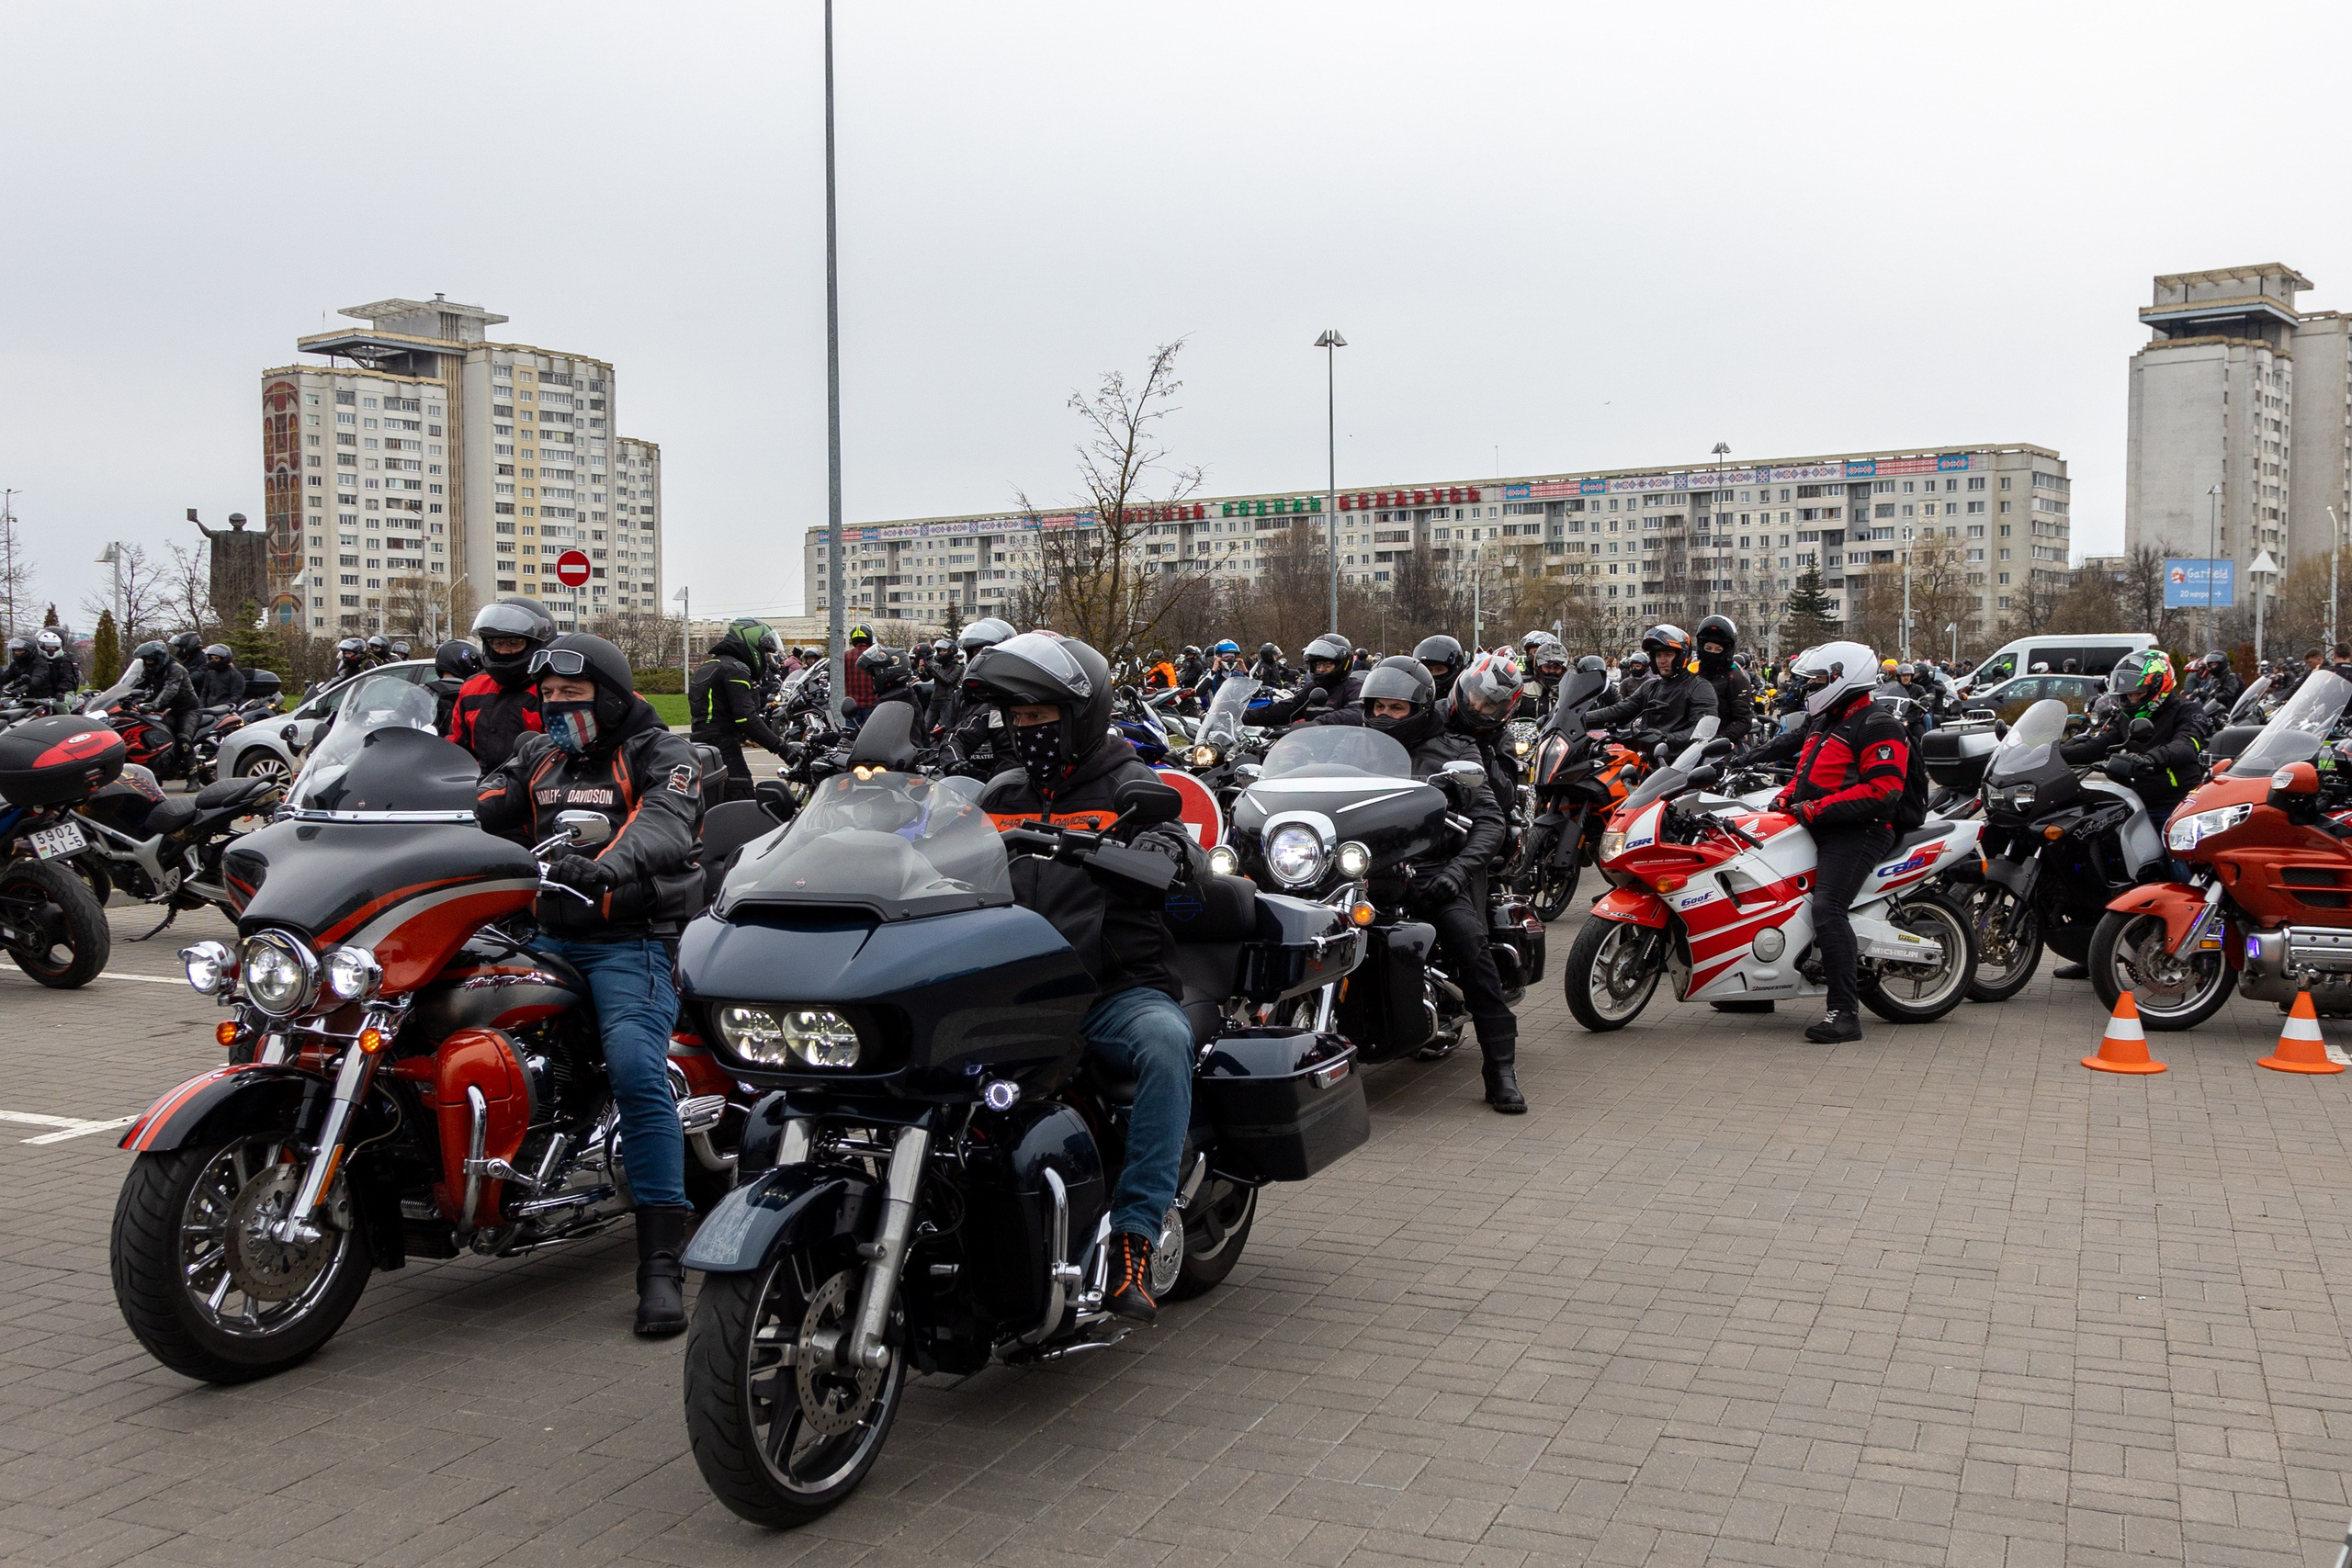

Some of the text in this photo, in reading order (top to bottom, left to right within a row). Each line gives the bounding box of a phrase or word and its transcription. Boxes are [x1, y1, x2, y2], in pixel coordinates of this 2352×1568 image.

[1339, 487, 1480, 510] БЕЛАРУСЬ
[2187, 568, 2229, 580] Garfeld
[2180, 590, 2189, 598] 20
[536, 789, 613, 806] HARLEY- DAVIDSON
[36, 825, 74, 844] 5902
[50, 835, 84, 856] AI-5
[1625, 837, 1654, 850] CBR
[1877, 856, 1925, 878] CBR
[1680, 890, 1714, 907] 600F
[1871, 947, 1918, 959] MICHELIN
